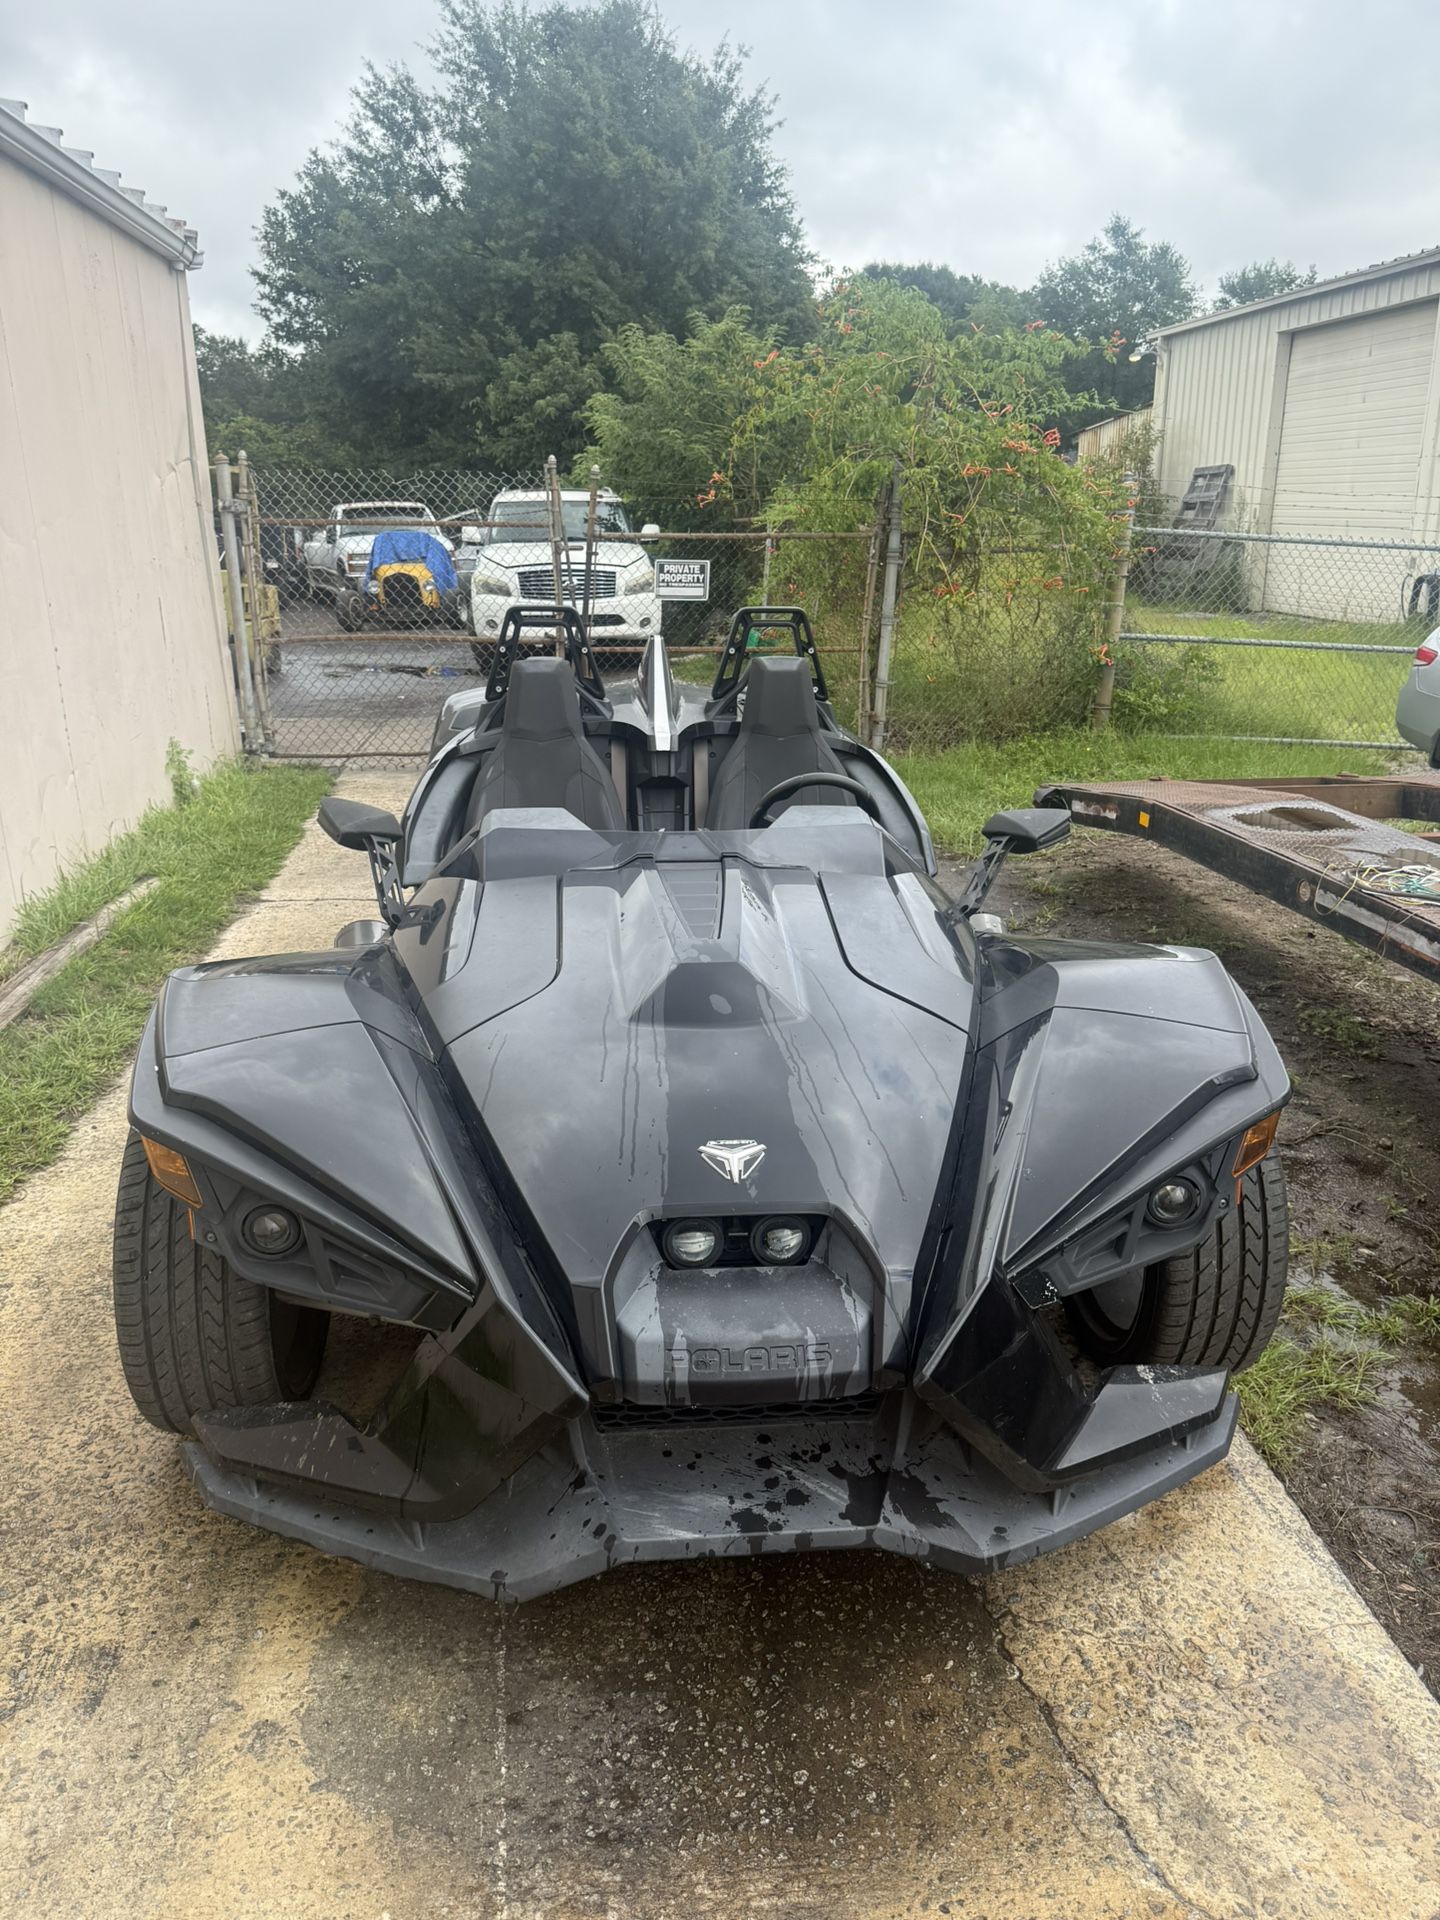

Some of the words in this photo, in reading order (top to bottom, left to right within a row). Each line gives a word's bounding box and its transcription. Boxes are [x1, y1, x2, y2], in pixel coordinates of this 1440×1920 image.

[664, 564, 700, 574] PRIVATE
[659, 574, 704, 582] PROPERTY
[664, 1342, 833, 1374] POLARIS
